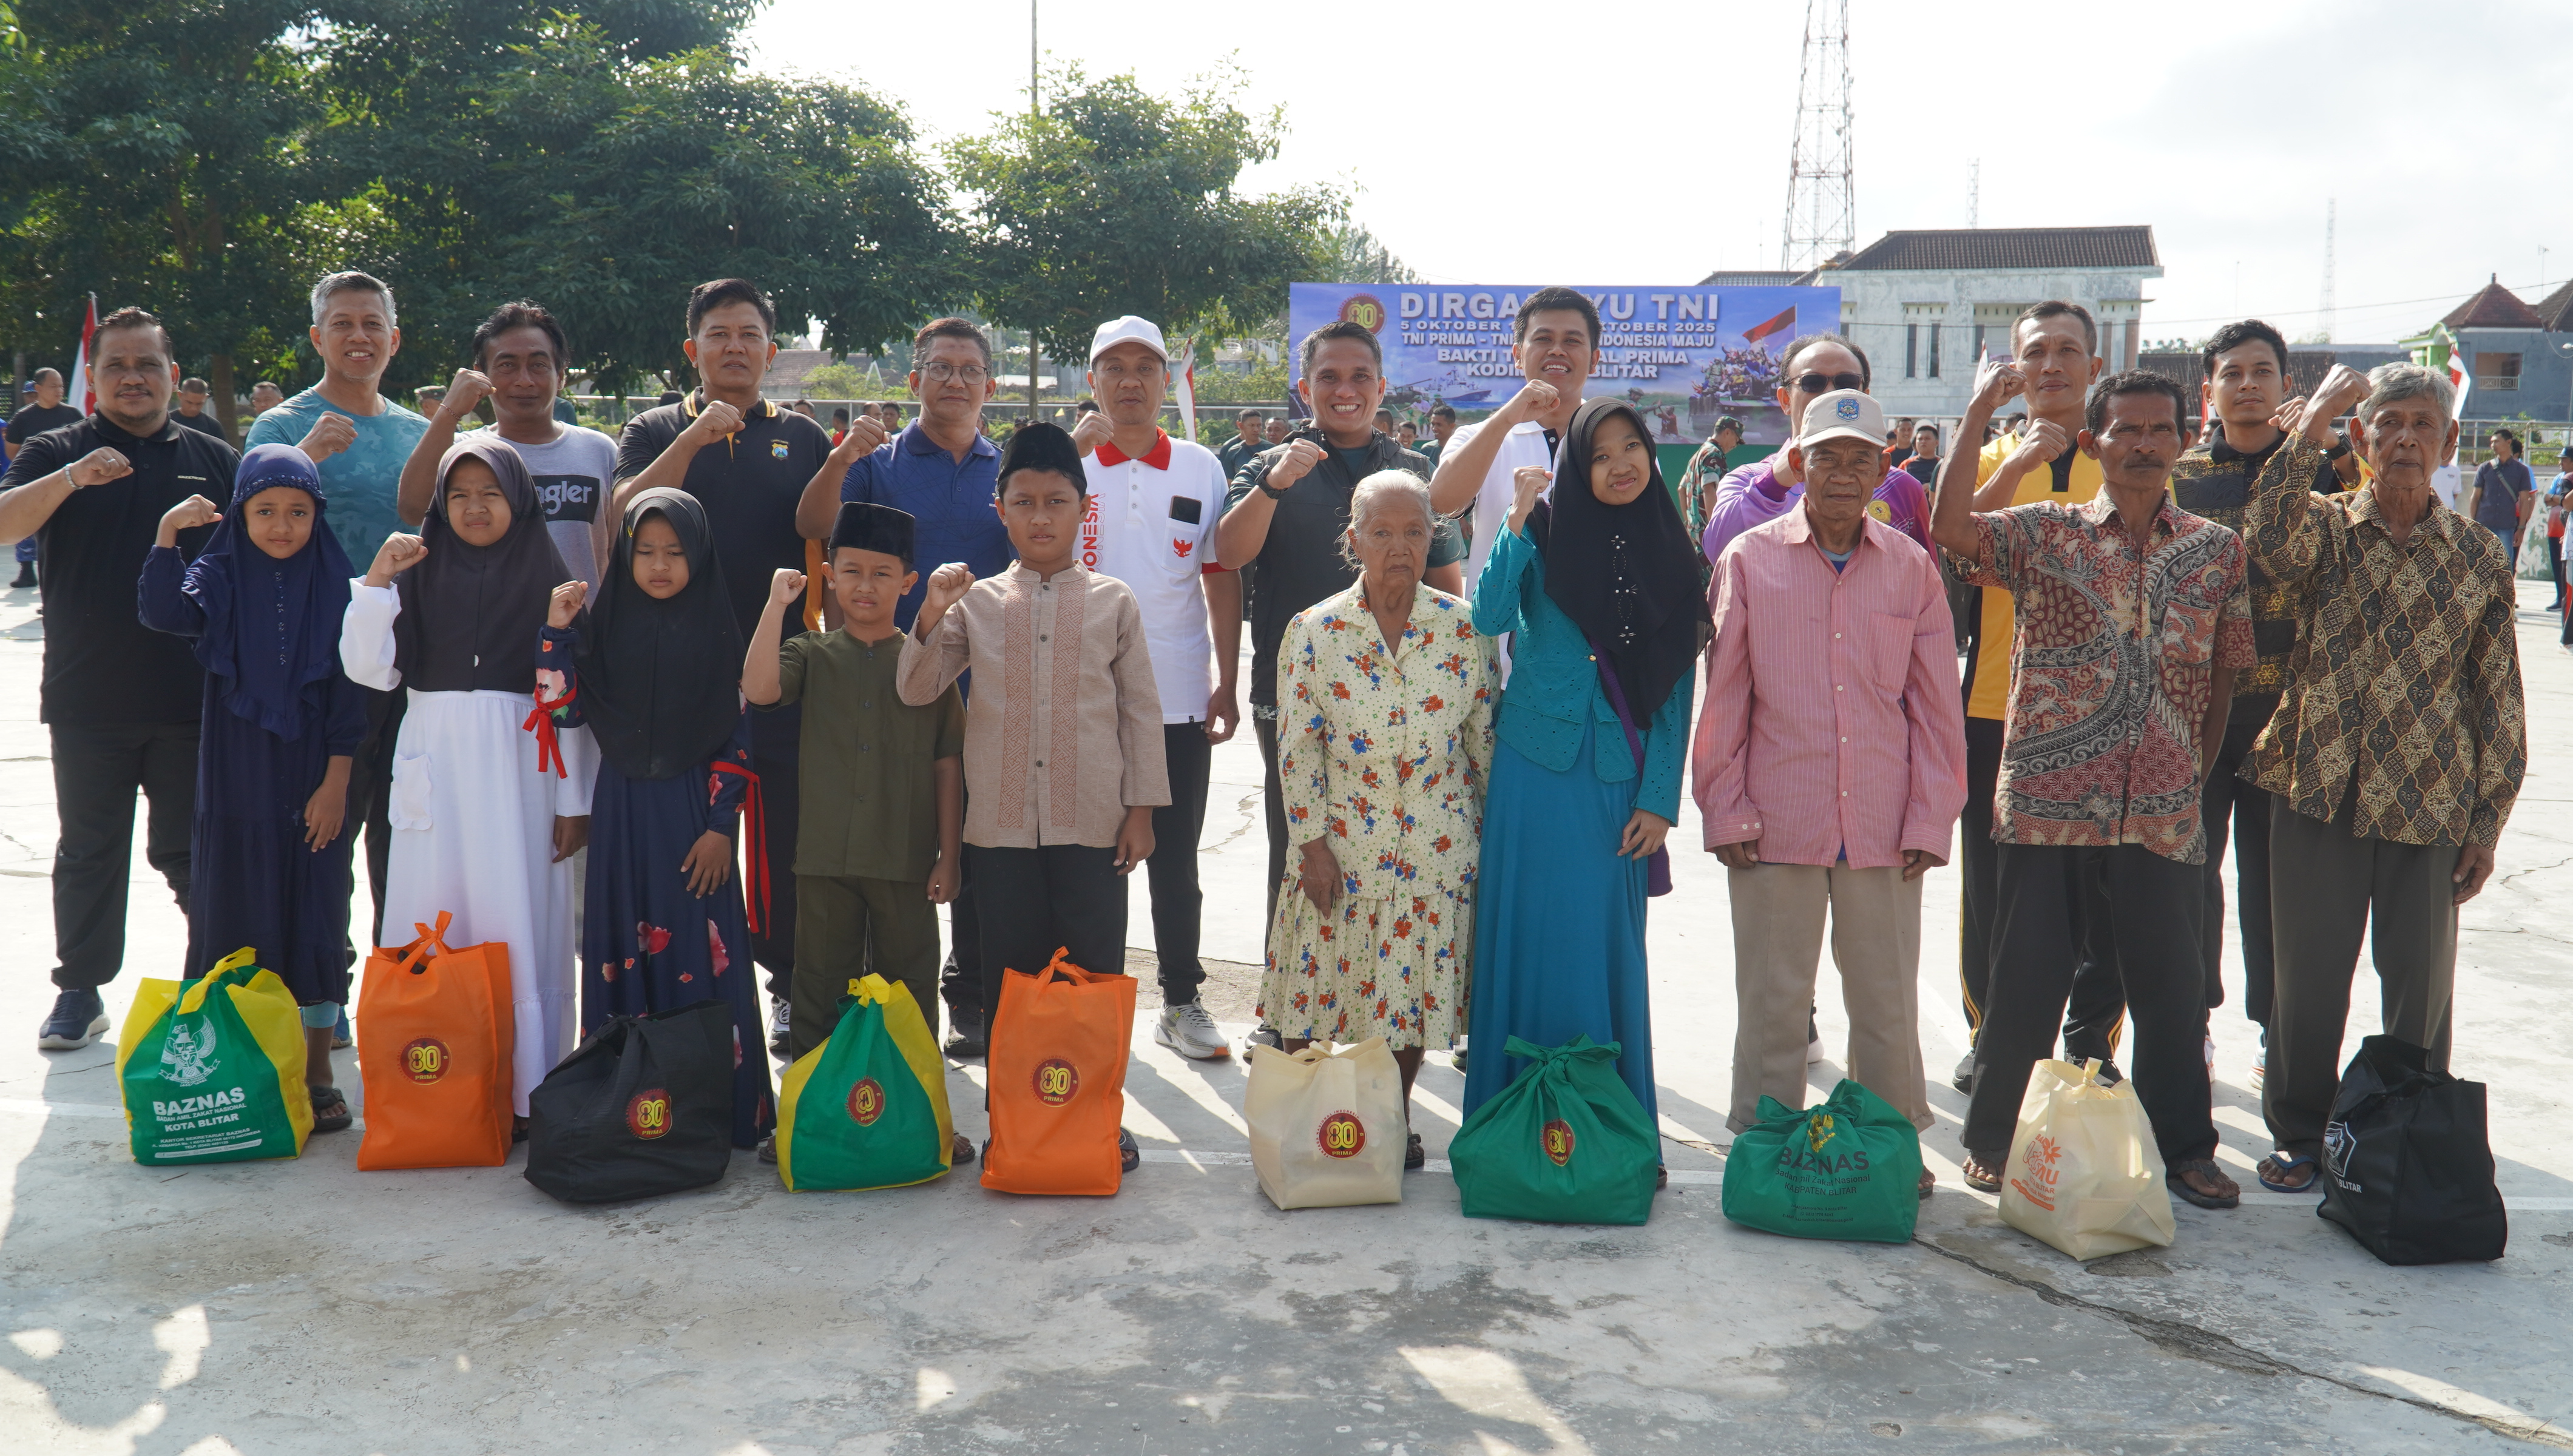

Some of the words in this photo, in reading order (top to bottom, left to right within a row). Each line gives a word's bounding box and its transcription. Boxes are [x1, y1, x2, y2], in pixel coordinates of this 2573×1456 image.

[1651, 294, 1718, 320] TNI
[1401, 321, 1409, 330] 5
[1416, 321, 1501, 331] OKTOBER
[1601, 322, 1668, 332] KTOBER
[1675, 323, 1716, 332] 2025
[1402, 333, 1424, 345] TNI
[1429, 333, 1475, 345] PRIMA
[1491, 334, 1513, 345] TNI
[1600, 334, 1668, 346] DONESIA
[1672, 335, 1714, 346] MAJU
[1438, 349, 1496, 362] BAKTI
[1625, 351, 1688, 363] PRIMA
[535, 480, 592, 514] ngler
[408, 1045, 441, 1073] 80
[1040, 1066, 1072, 1095] 80
[153, 1087, 245, 1116] BAZNAS
[192, 1109, 214, 1118] ZAKAT
[214, 1103, 247, 1114] NASIONAL
[164, 1122, 195, 1132] KOTA
[198, 1113, 240, 1128] BLITAR
[637, 1099, 666, 1128] 80
[186, 1132, 225, 1141] SEKRETARIAT
[226, 1127, 251, 1136] BAZNAS
[1327, 1121, 1358, 1149] 80
[1779, 1146, 1870, 1176] BAZNAS
[1835, 1174, 1870, 1184] Nasional
[2338, 1179, 2362, 1193] BLITAR
[1828, 1186, 1857, 1196] BLITAR
